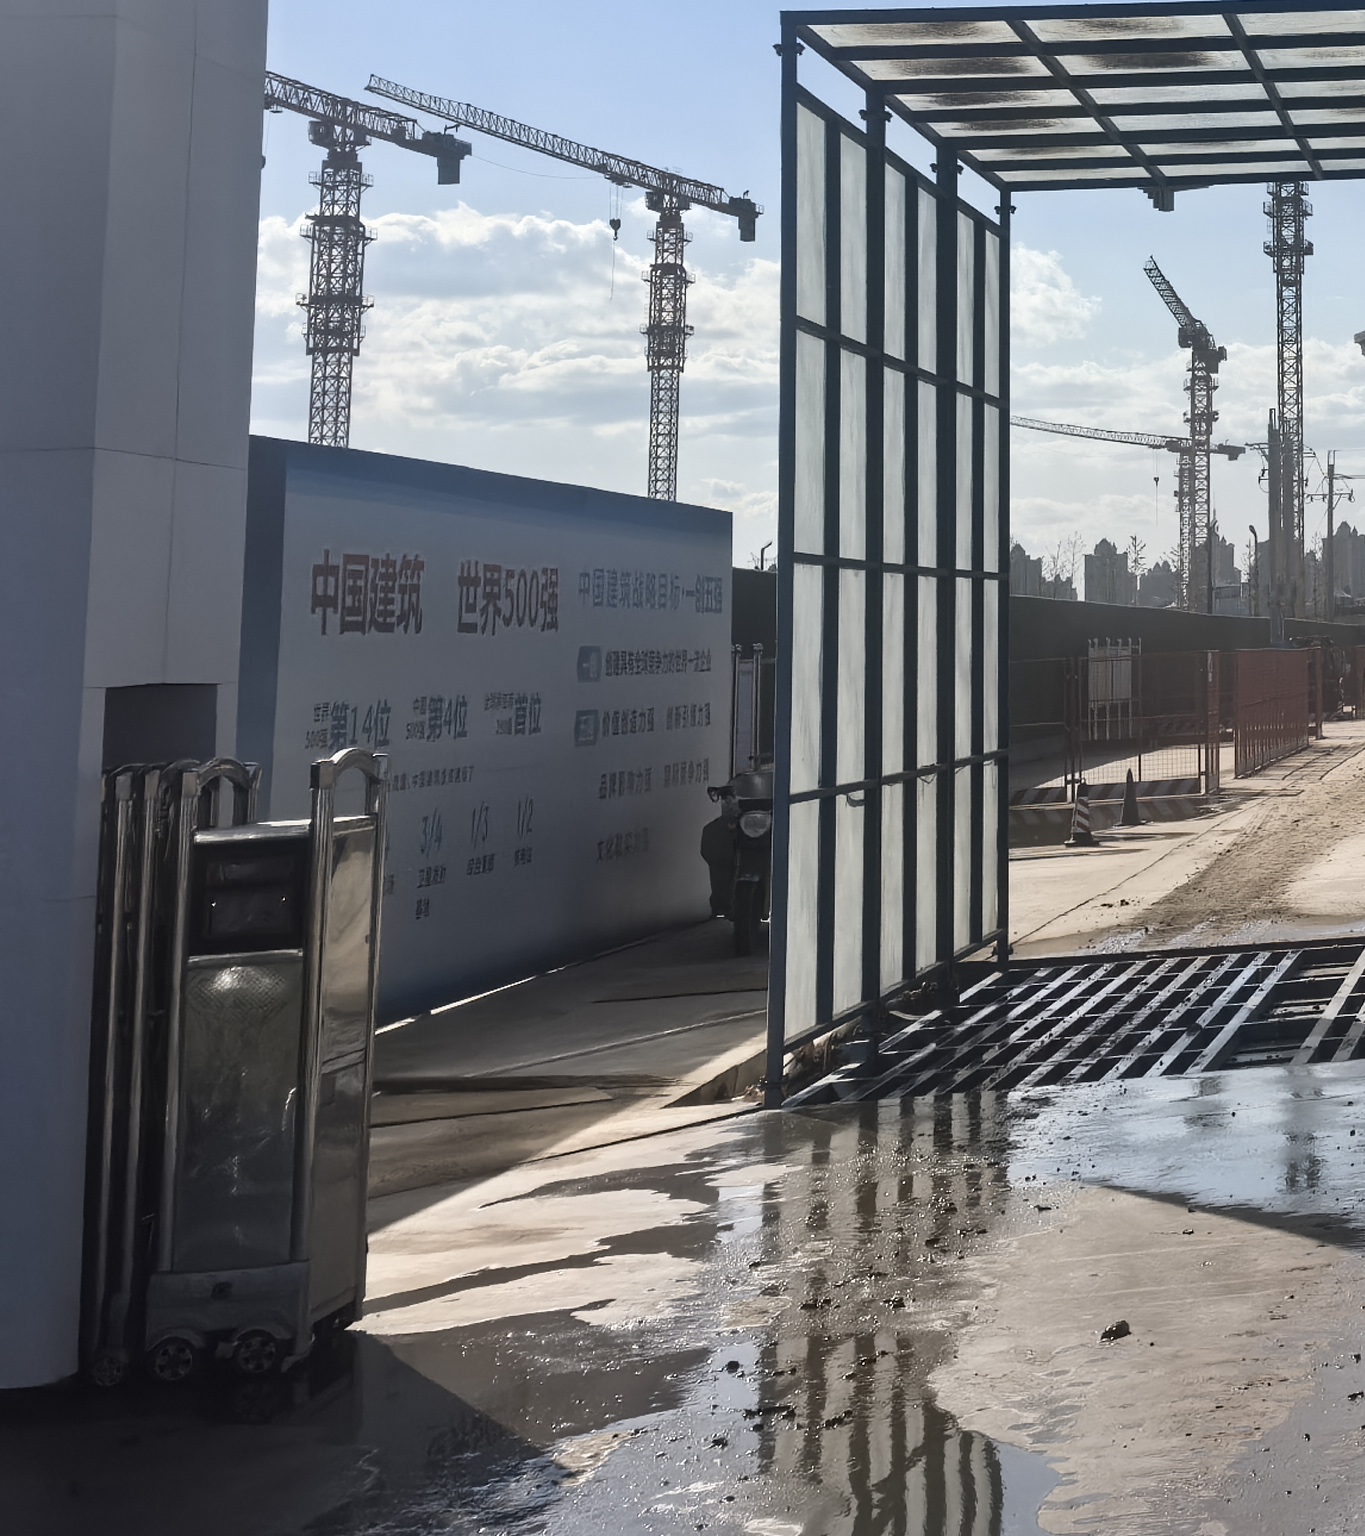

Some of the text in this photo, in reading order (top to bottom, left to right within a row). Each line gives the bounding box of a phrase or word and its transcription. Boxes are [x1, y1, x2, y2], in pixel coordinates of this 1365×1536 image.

[310, 548, 560, 637] 中国建筑 世界500强
